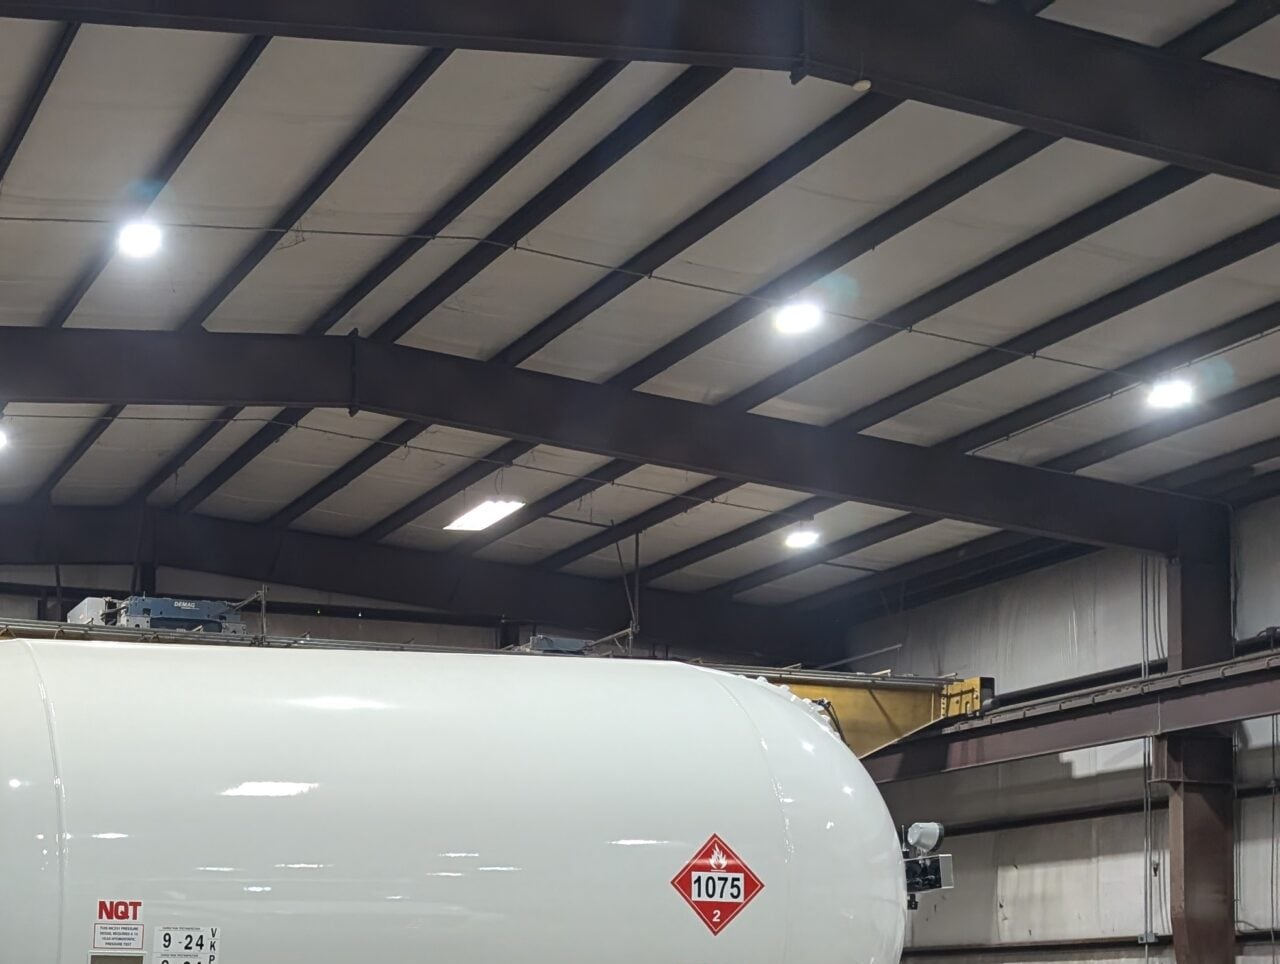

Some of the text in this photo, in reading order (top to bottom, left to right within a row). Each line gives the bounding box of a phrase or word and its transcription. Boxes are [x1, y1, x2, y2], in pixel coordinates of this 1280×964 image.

[693, 875, 741, 899] 1075
[98, 900, 142, 920] NQT
[712, 910, 721, 922] 2
